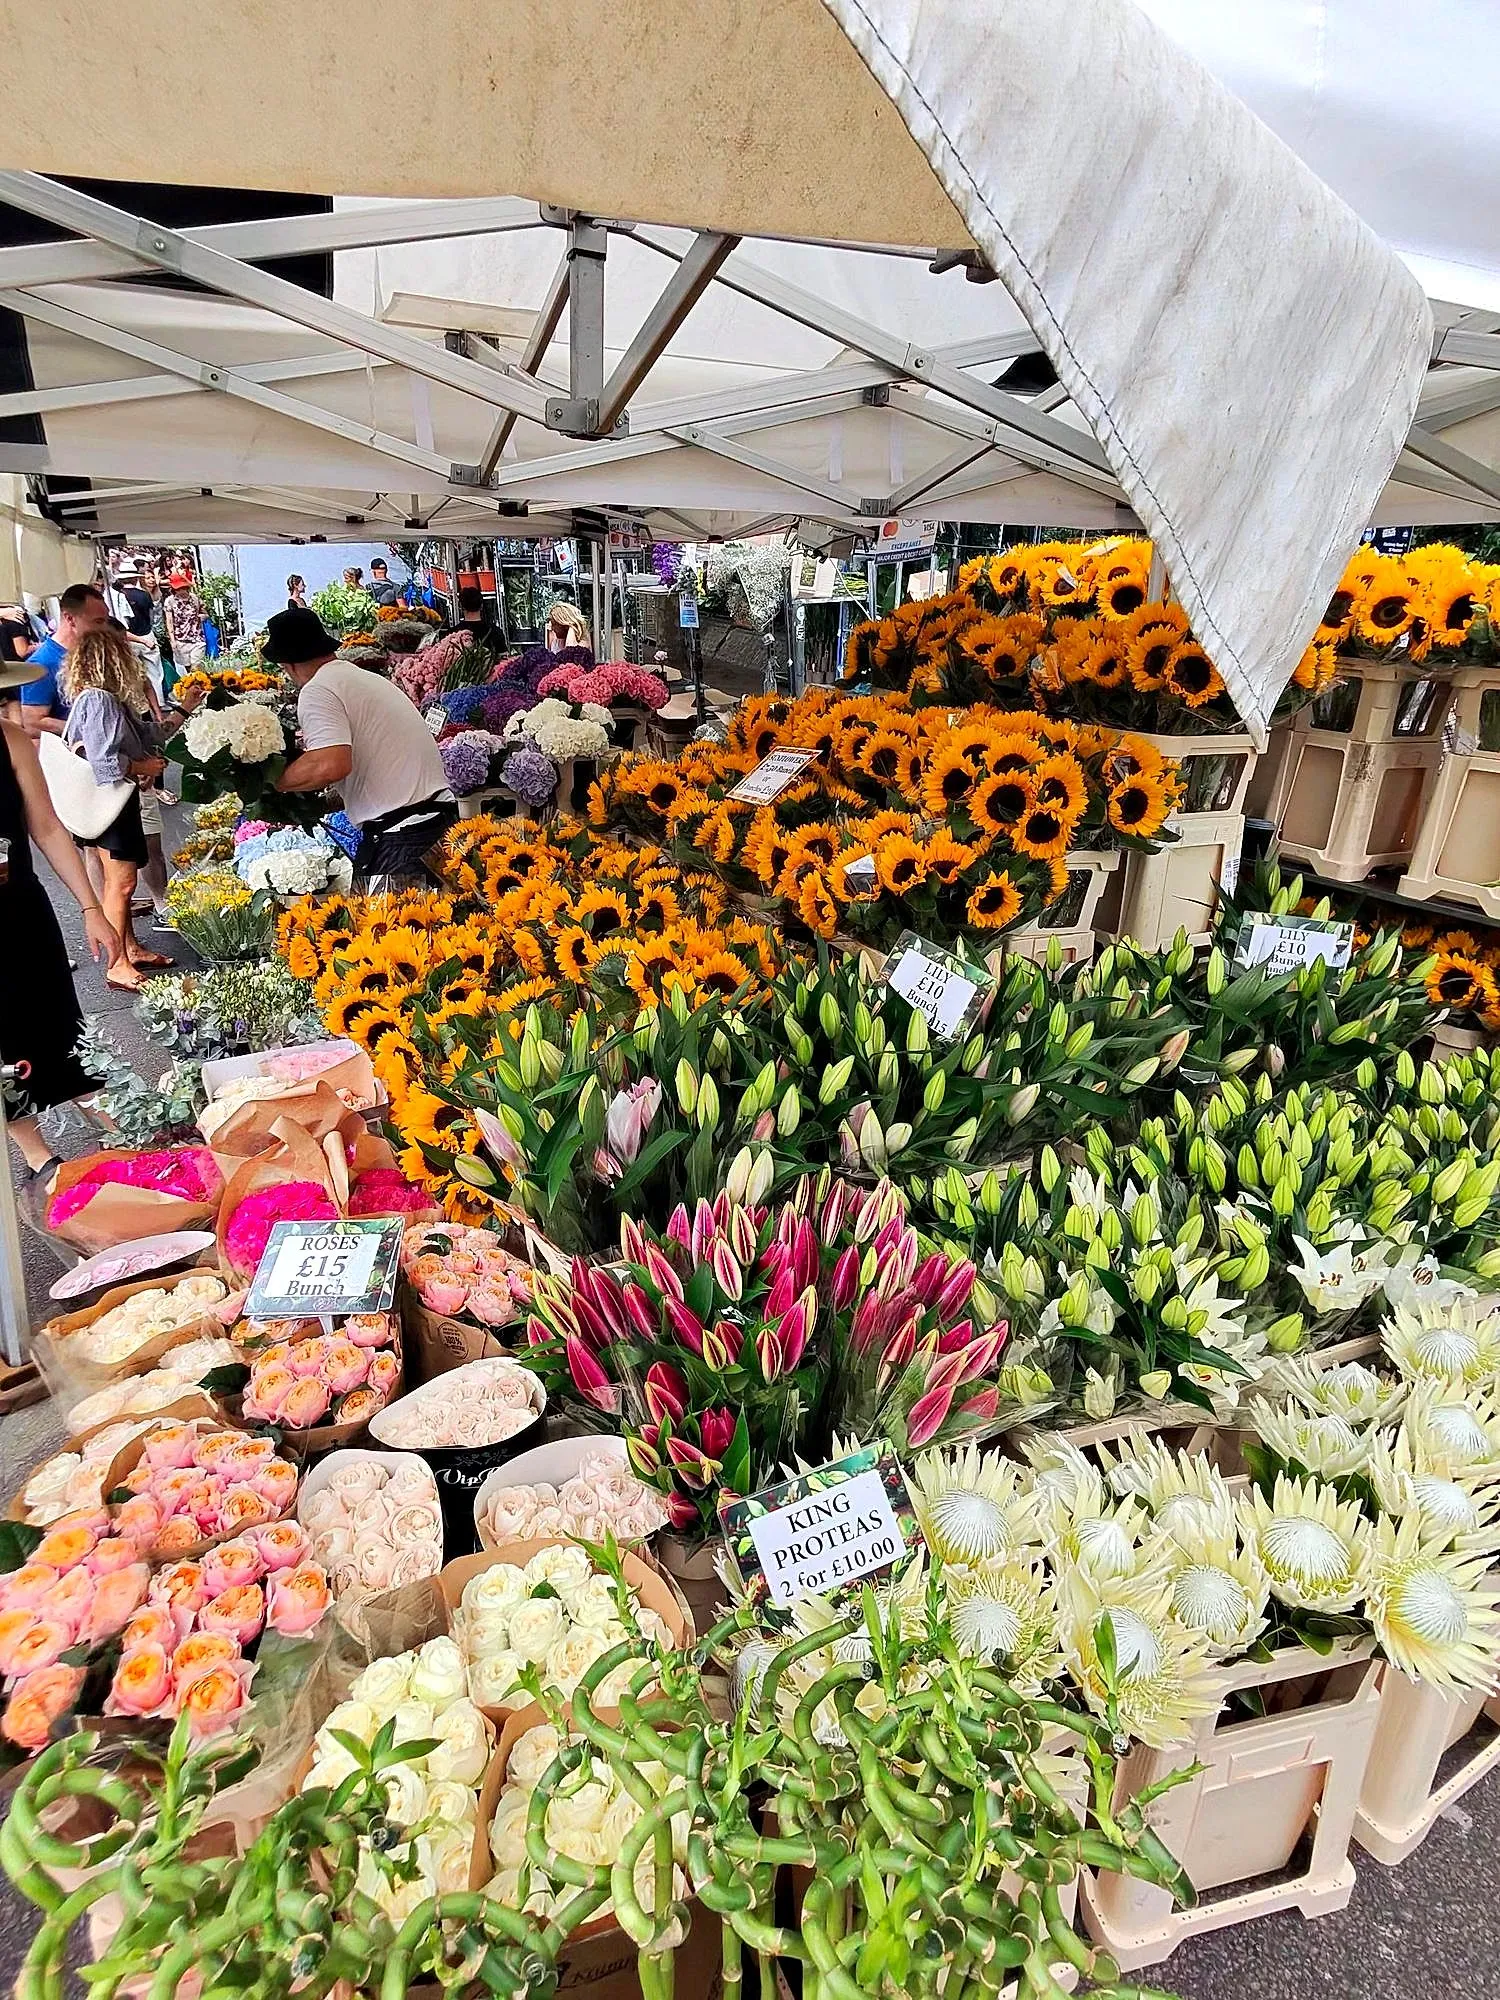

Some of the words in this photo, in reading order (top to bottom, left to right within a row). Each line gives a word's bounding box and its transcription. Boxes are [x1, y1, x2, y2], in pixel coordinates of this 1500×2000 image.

[1279, 929, 1309, 941] LILY
[1276, 941, 1306, 956] £10
[924, 962, 953, 984] LILY
[916, 977, 944, 999] £10
[906, 989, 938, 1015] Bunch
[300, 1236, 360, 1251] ROSES
[296, 1255, 348, 1277] £15
[285, 1280, 344, 1296] Bunch
[786, 1492, 850, 1534] KING
[772, 1509, 883, 1570] PROTEAS
[780, 1580, 794, 1598] 2
[798, 1571, 827, 1589] for
[832, 1537, 895, 1577] £10.00
